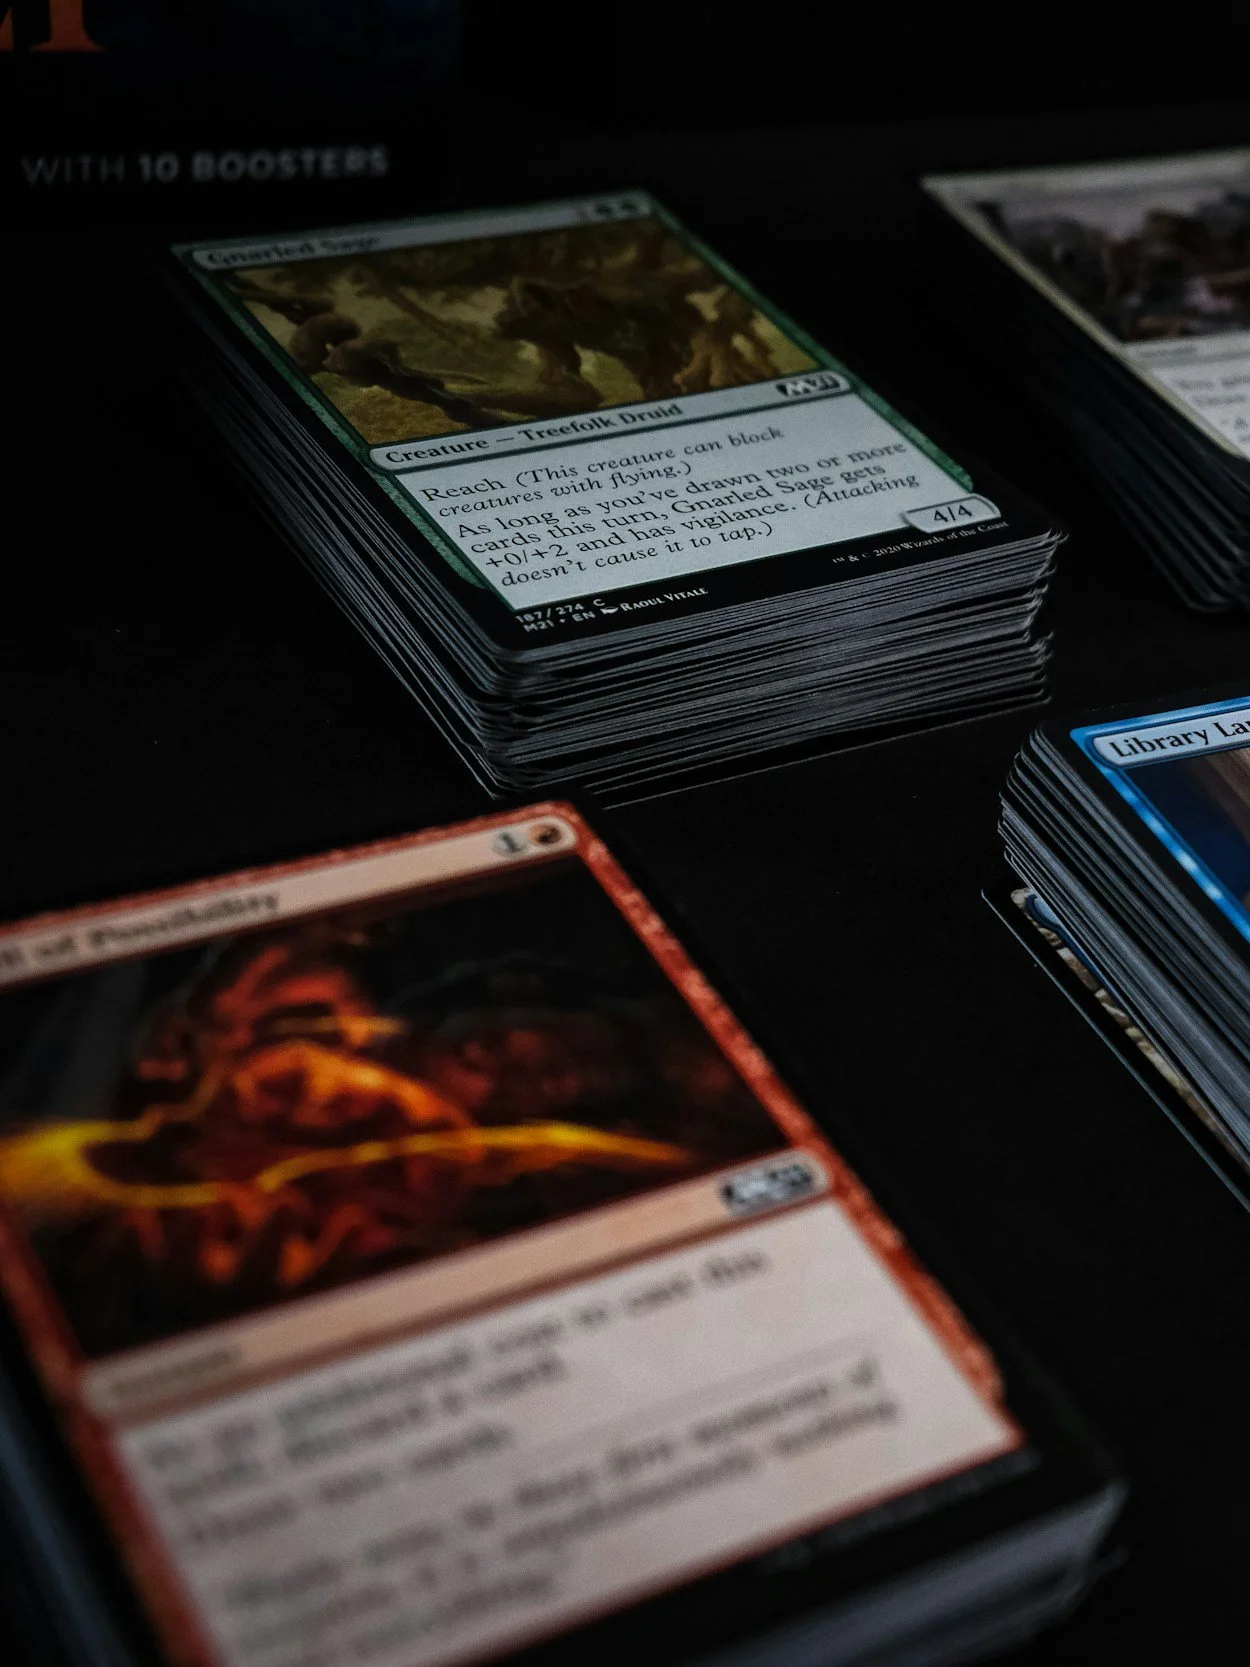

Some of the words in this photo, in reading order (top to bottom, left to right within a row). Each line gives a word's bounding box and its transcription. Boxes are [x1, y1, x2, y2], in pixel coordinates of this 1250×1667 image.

[20, 153, 126, 186] WITH
[138, 149, 181, 184] 10
[190, 144, 390, 185] BOOSTERS
[207, 237, 315, 266] Gnarled
[385, 436, 488, 465] Creature
[518, 415, 616, 442] Treefolk
[620, 404, 684, 426] Druid
[421, 476, 507, 501] Reach
[516, 466, 578, 488] (This
[587, 449, 675, 473] creature
[684, 439, 720, 456] can
[730, 426, 784, 447] block
[438, 489, 543, 517] creatures
[551, 479, 602, 497] with
[608, 460, 692, 490] flying.)
[456, 522, 491, 538] As
[499, 512, 554, 532] long
[564, 504, 590, 518] as
[596, 487, 679, 515] you've
[686, 474, 761, 495] drawn
[768, 462, 809, 479] two
[817, 455, 842, 468] or
[848, 442, 906, 464] more
[470, 531, 541, 553] cards
[548, 522, 596, 540] this
[602, 508, 668, 529] turn,
[671, 486, 772, 514] Gnarled
[776, 474, 834, 495] Sage
[840, 464, 885, 483] gets
[485, 544, 569, 569] +0/+2
[577, 533, 626, 552] and
[635, 523, 675, 541] has
[682, 500, 797, 532] vigilance.
[803, 473, 920, 508] (Attacking
[933, 504, 973, 523] 4/4
[501, 559, 587, 586] doesn't
[595, 545, 659, 568] cause
[665, 540, 684, 553] it
[691, 535, 711, 548] to
[720, 521, 773, 543] tap.)
[873, 545, 901, 557] 2020
[900, 535, 945, 550] Wizards
[947, 530, 959, 540] of
[959, 529, 977, 538] the
[522, 618, 555, 633] M21
[573, 610, 597, 623] EN
[592, 598, 606, 608] C
[1108, 725, 1209, 760] Library
